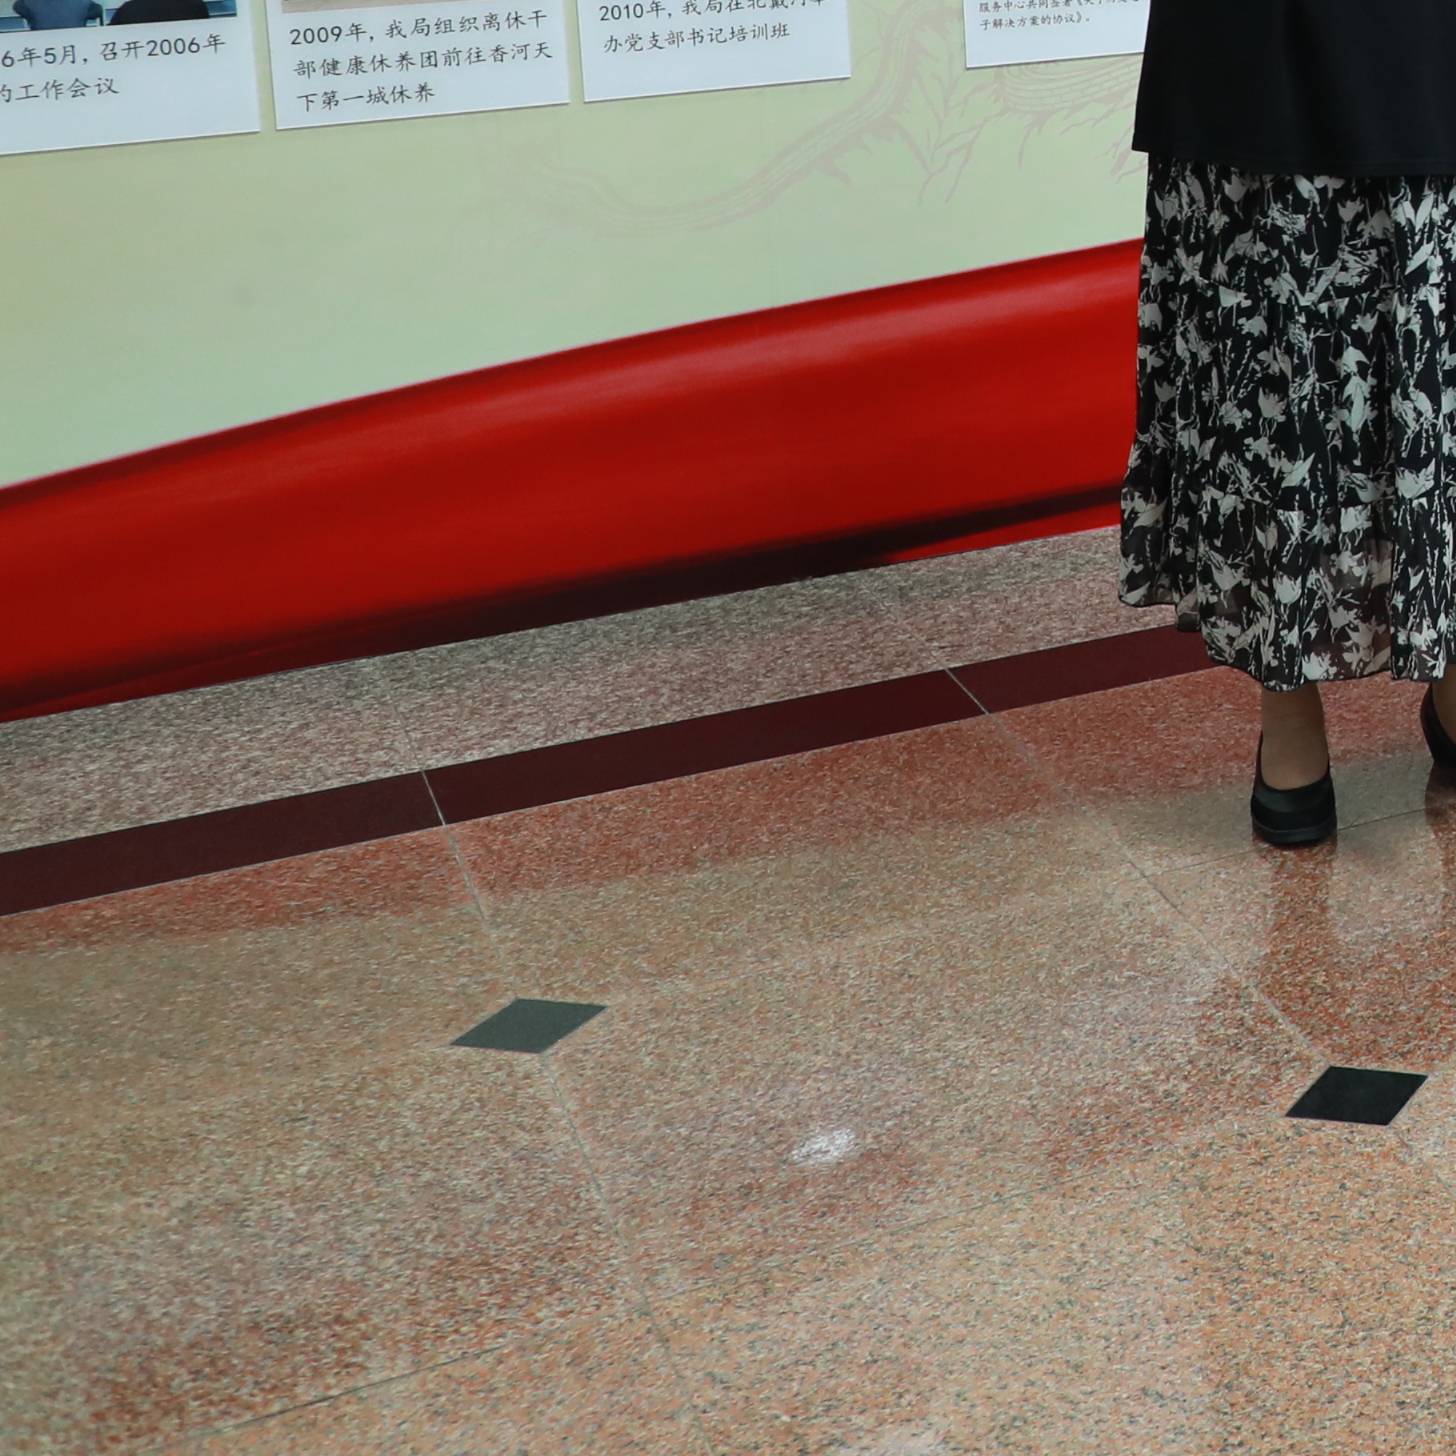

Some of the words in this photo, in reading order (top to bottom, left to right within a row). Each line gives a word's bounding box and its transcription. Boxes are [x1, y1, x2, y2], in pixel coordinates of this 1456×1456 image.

[290, 10, 548, 46] 2009年，我局组织离休干
[602, 22, 791, 55] 办党支部书记培训班
[294, 41, 554, 79] 部健康休养团前往香河天
[297, 81, 435, 112] 下第一城休养
